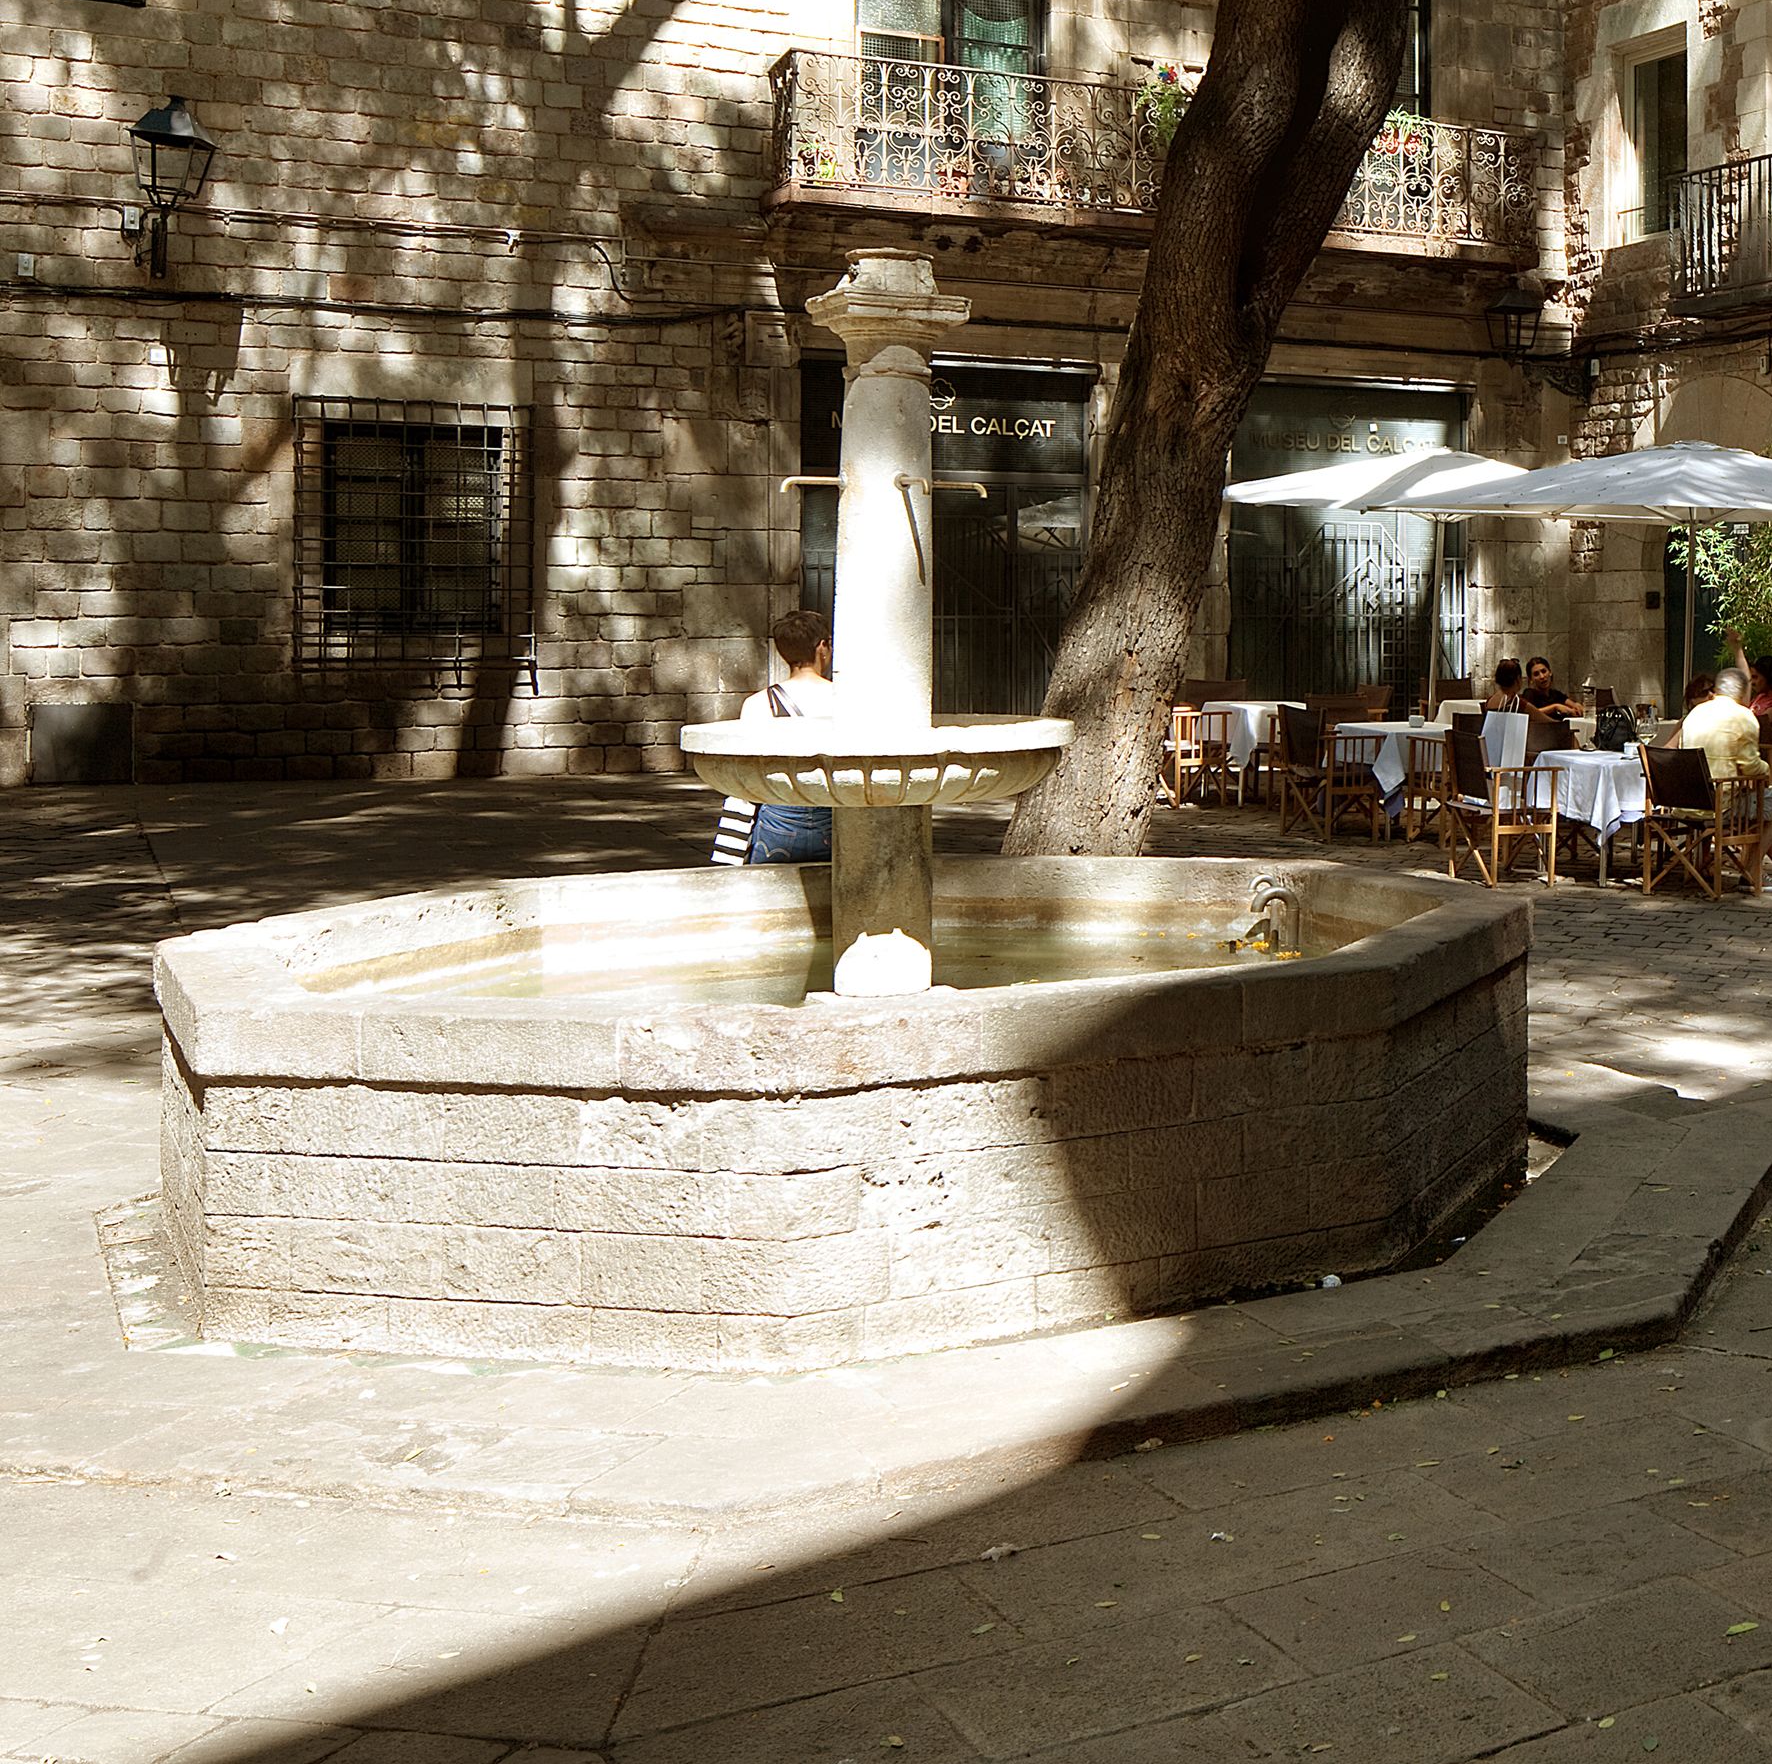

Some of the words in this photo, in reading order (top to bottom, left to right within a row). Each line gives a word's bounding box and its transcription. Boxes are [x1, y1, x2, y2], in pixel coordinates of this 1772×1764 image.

[971, 417, 1056, 439] CALÇAT
[1249, 430, 1320, 451] MUSEU
[1327, 433, 1361, 452] DEL
